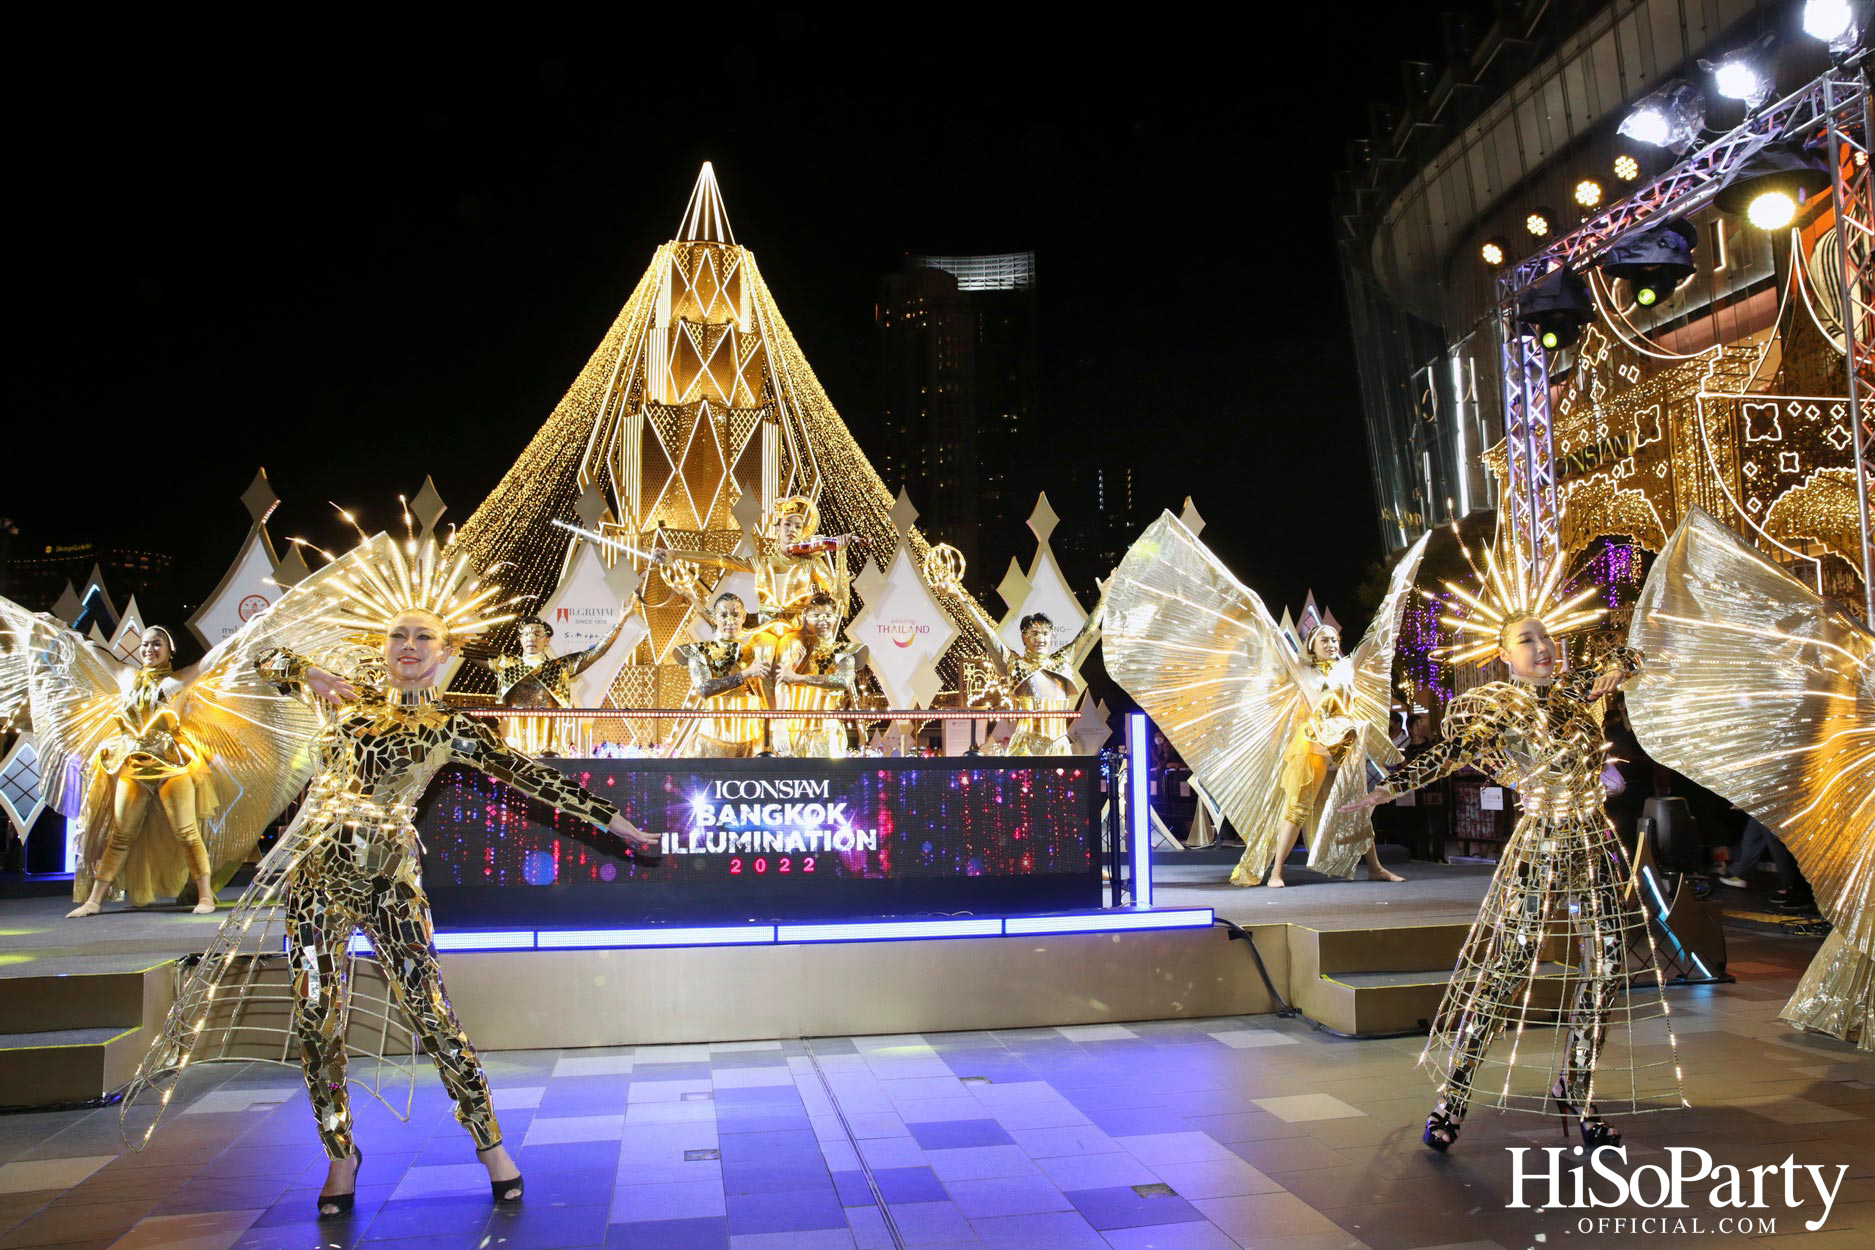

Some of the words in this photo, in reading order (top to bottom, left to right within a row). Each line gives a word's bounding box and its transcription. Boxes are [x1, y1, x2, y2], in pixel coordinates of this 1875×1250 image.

[569, 607, 613, 617] B.GRIMM
[877, 624, 930, 634] THAILAND
[714, 779, 830, 799] ICONSIAM
[696, 802, 848, 827] BANGKOK
[661, 829, 878, 855] ILLUMINATION
[729, 857, 816, 874] 2022
